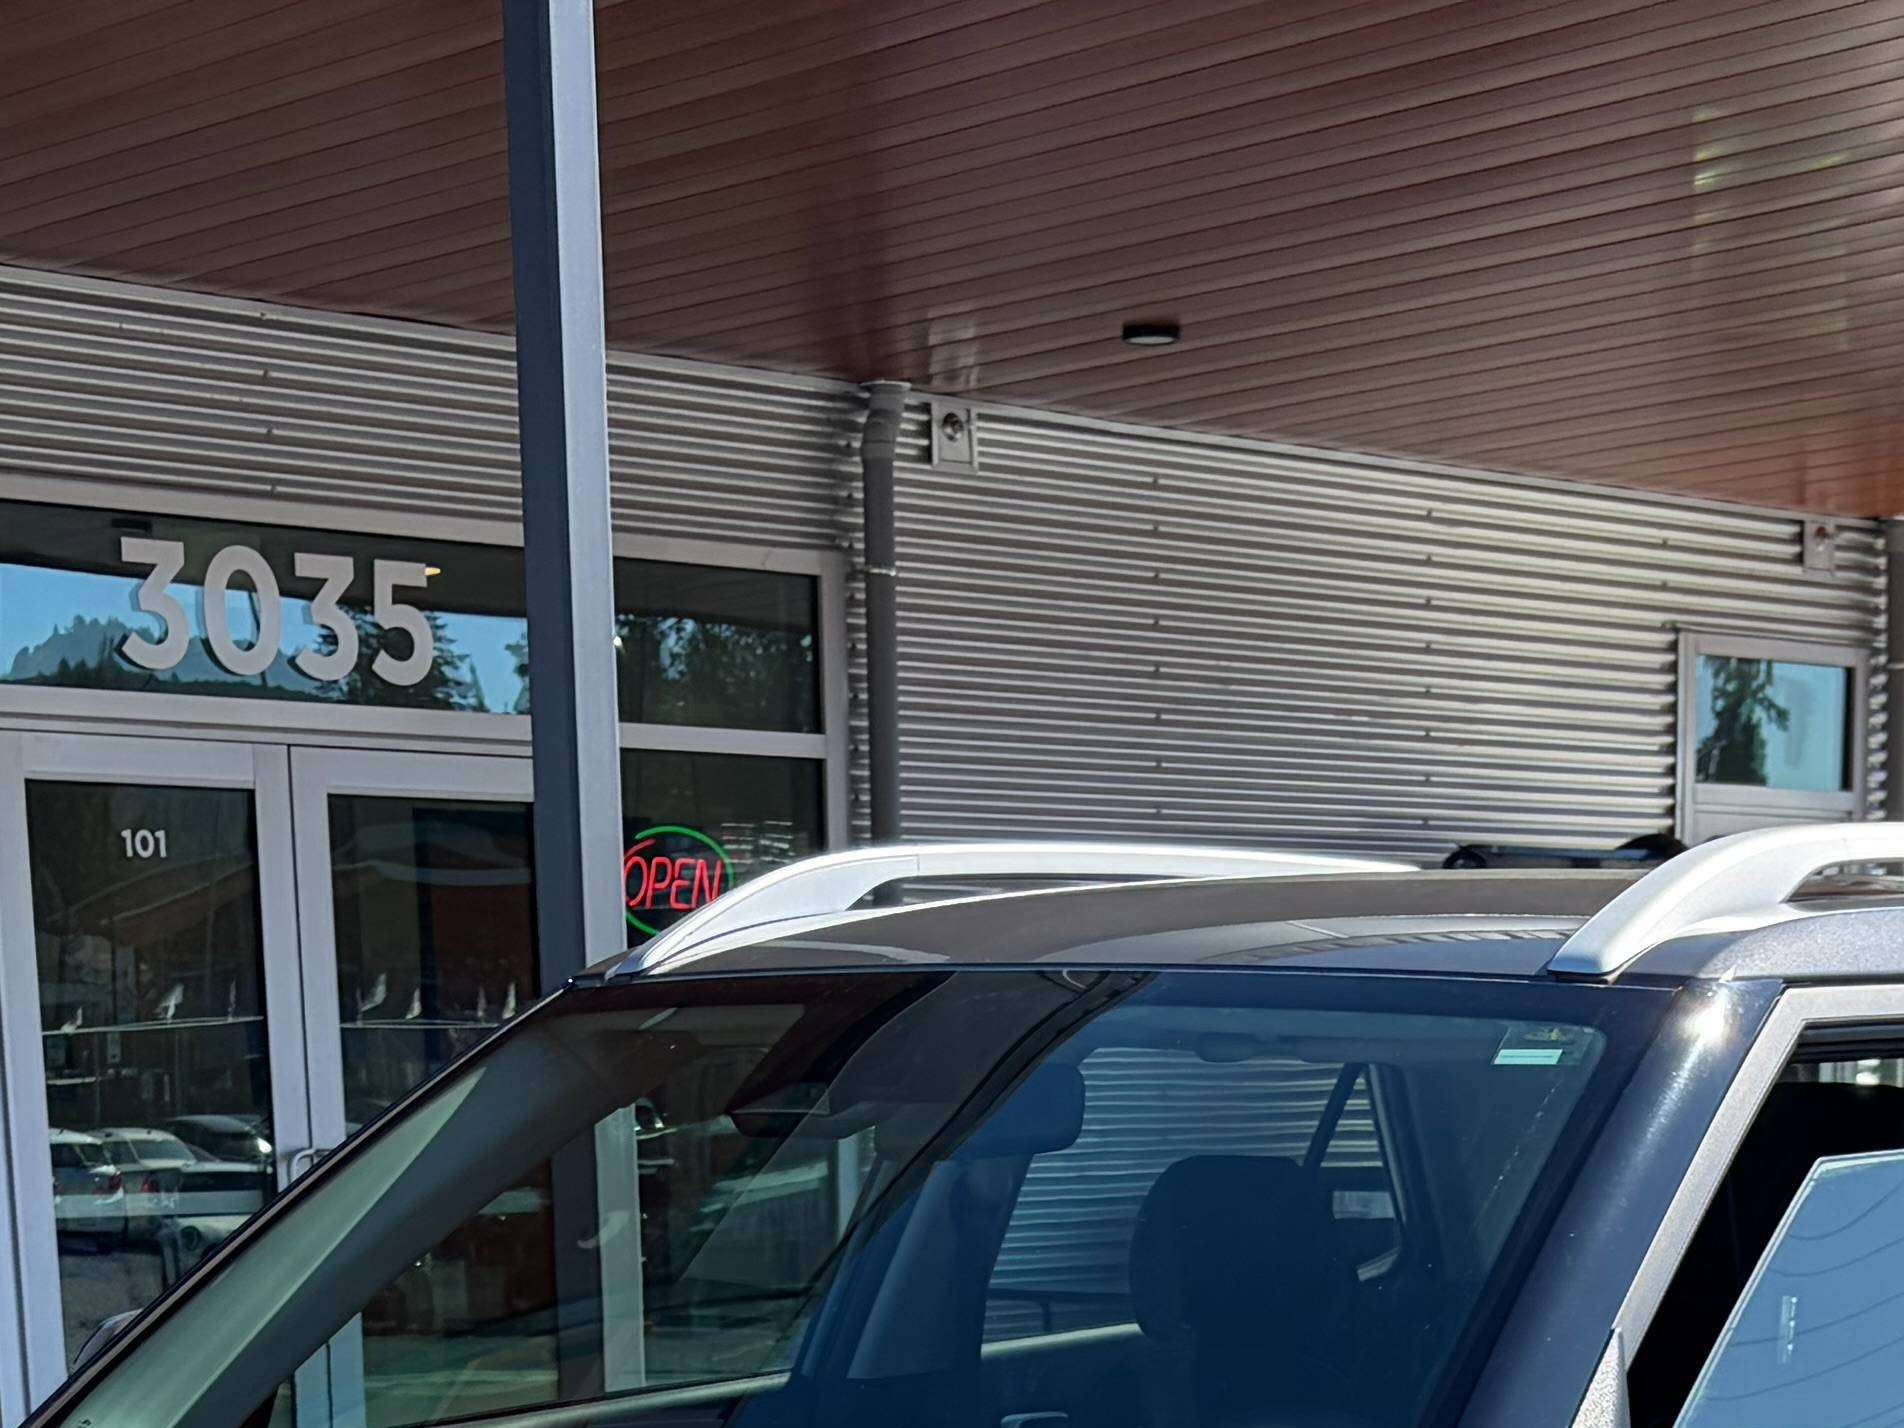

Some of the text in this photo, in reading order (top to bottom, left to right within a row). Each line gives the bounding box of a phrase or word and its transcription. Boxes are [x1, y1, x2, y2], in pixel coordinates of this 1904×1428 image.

[121, 536, 434, 687] 3035
[121, 829, 167, 858] 101
[624, 855, 725, 910] OPEN
